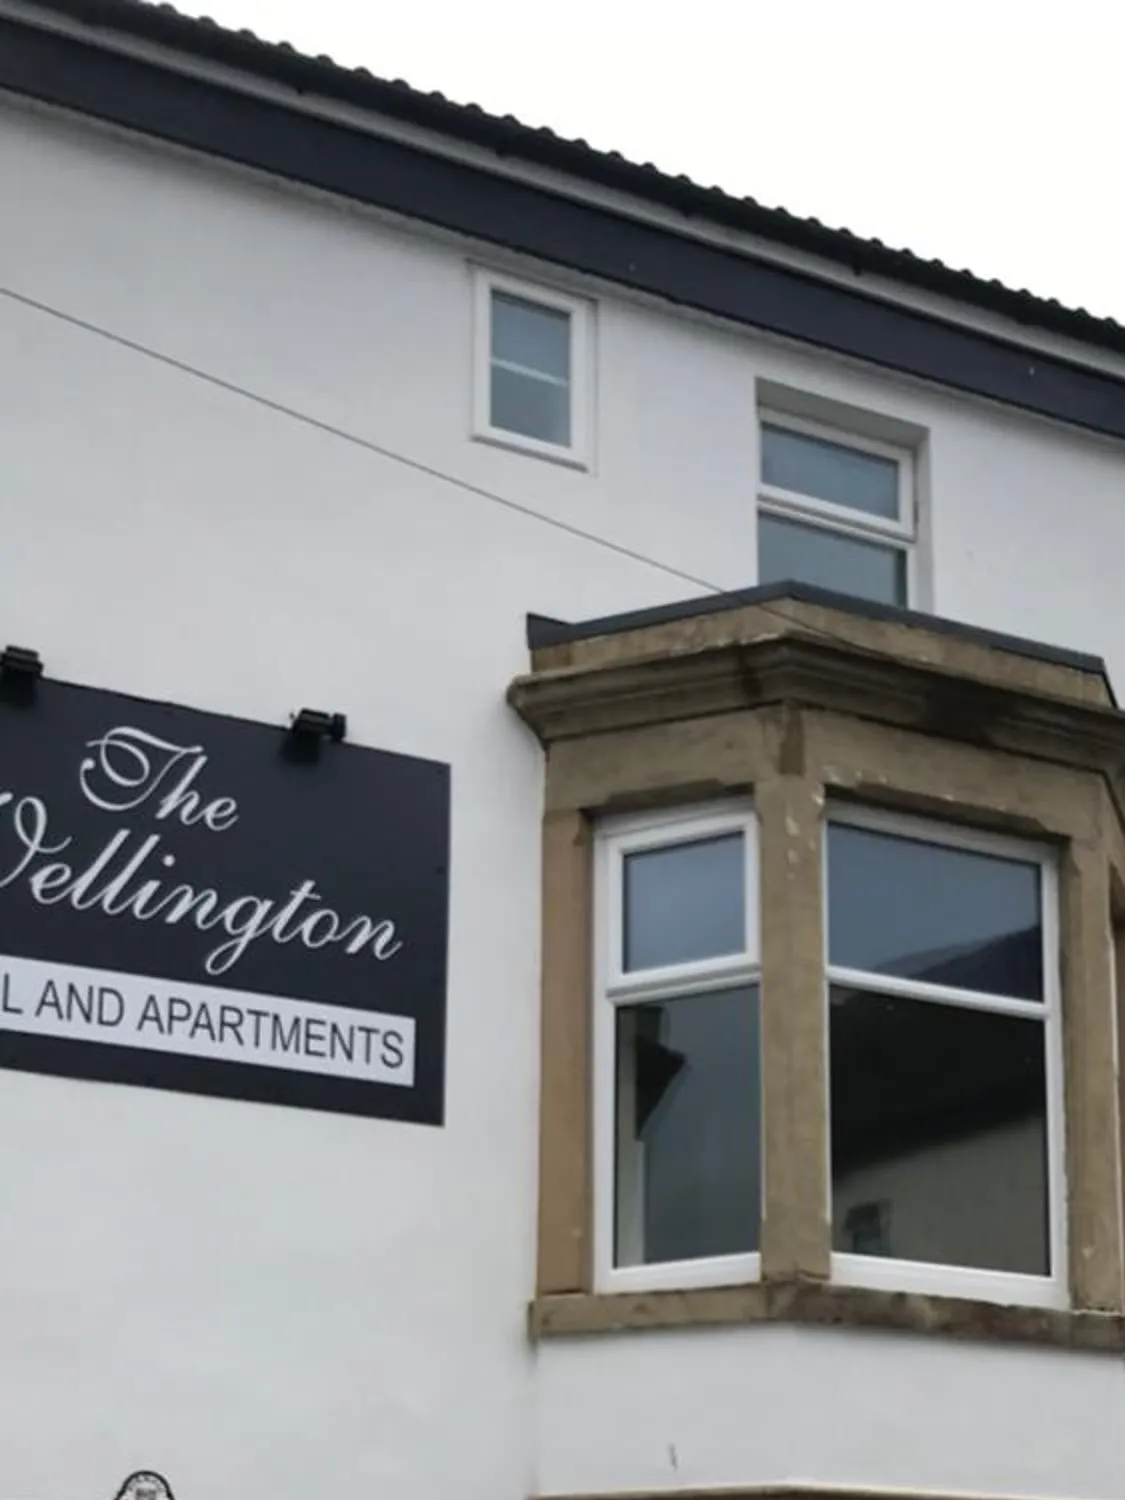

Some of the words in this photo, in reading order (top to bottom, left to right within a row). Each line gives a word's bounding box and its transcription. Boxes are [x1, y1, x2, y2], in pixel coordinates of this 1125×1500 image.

[80, 725, 239, 832] The
[35, 979, 125, 1028] AND
[136, 993, 405, 1069] APARTMENTS
